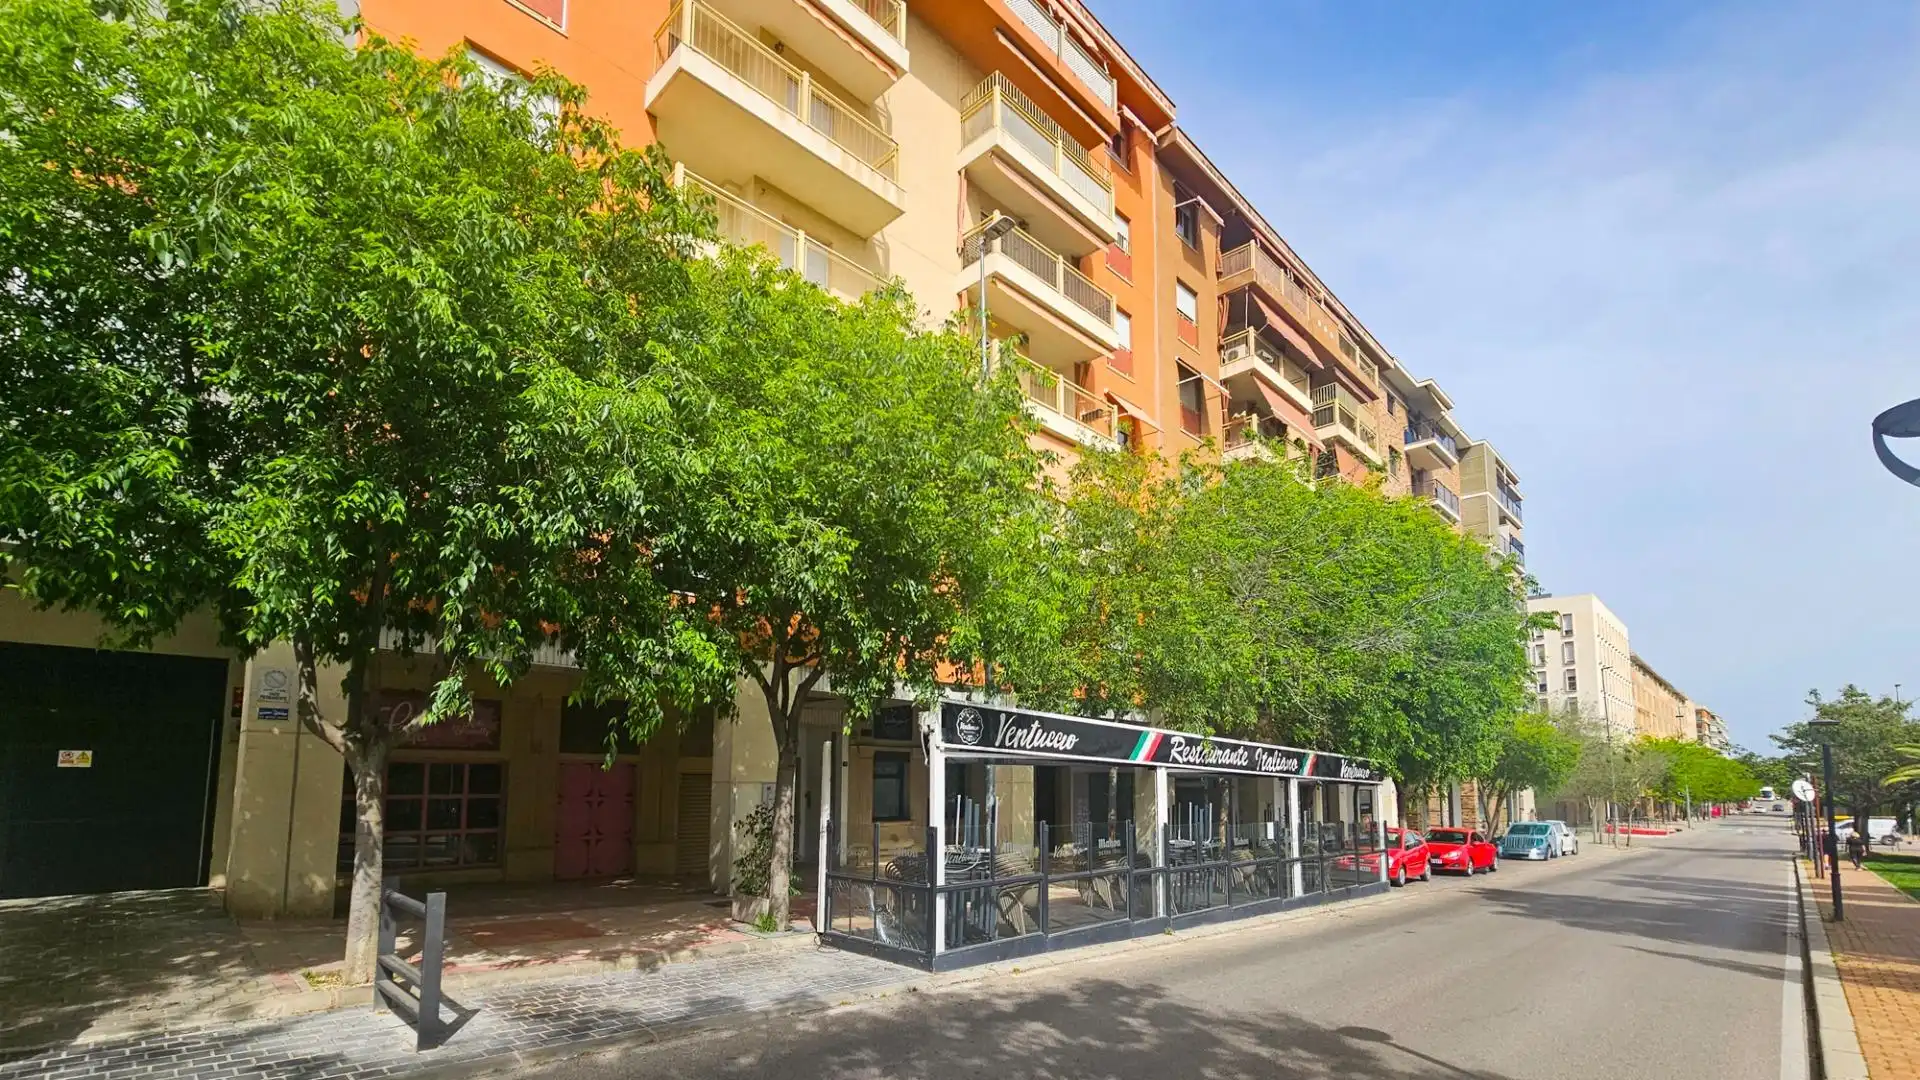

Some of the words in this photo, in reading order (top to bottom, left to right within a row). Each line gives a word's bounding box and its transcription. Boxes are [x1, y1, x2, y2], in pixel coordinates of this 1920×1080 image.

[995, 712, 1080, 751] Ventuccio
[1168, 736, 1249, 767] Restaurante
[1255, 747, 1299, 773] Italiano
